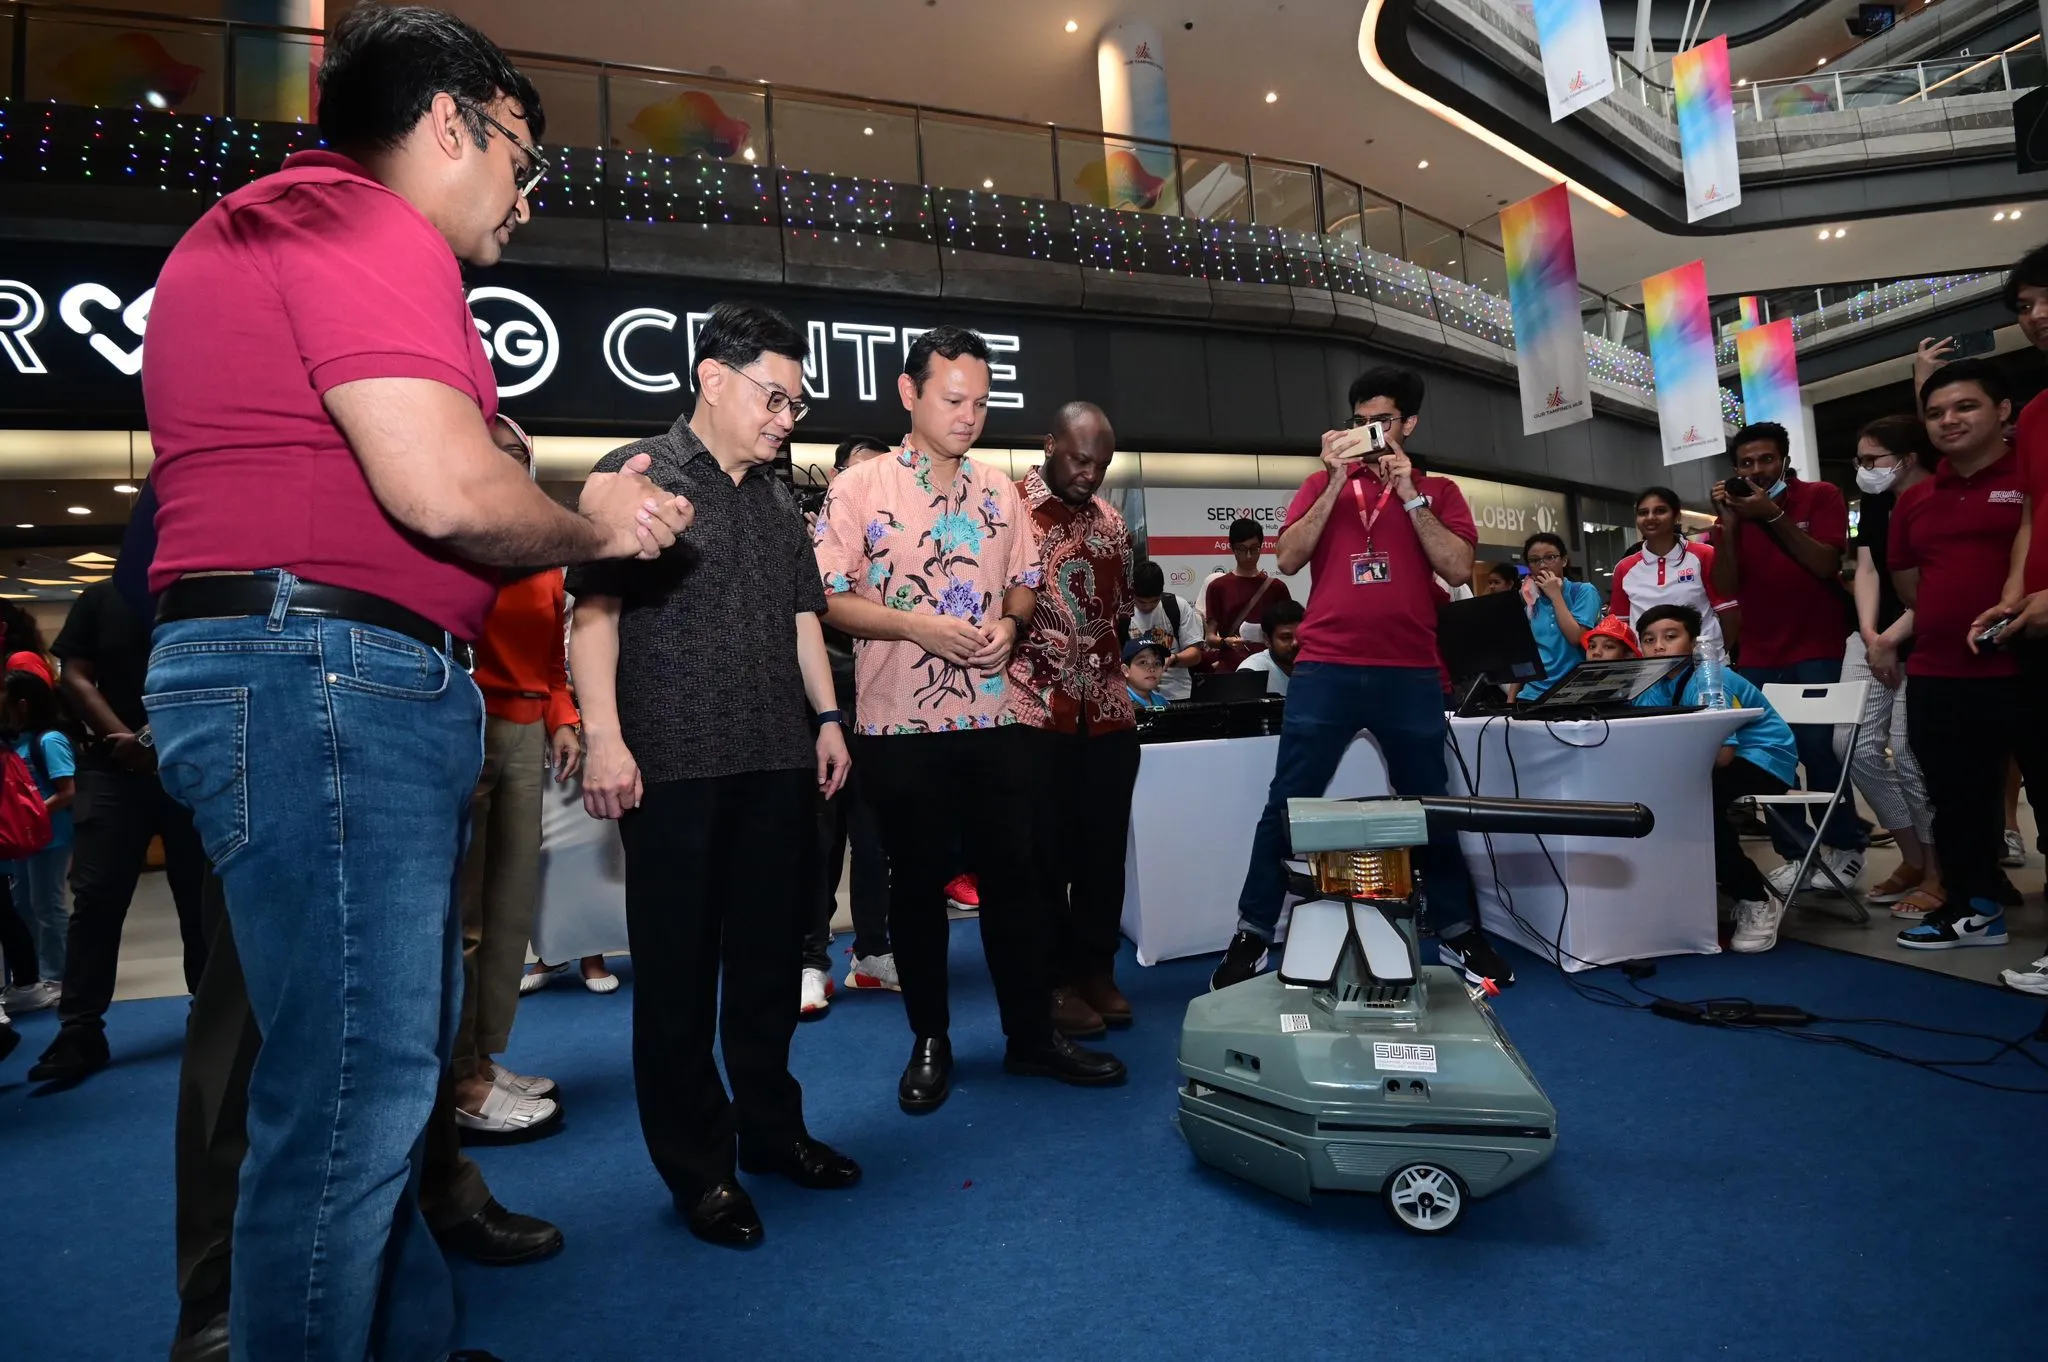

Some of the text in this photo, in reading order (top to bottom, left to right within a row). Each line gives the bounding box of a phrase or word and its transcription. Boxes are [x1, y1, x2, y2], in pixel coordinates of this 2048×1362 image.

[603, 307, 1024, 408] CNTE
[1472, 503, 1526, 532] LOBBY
[1375, 1044, 1434, 1060] SUTD
